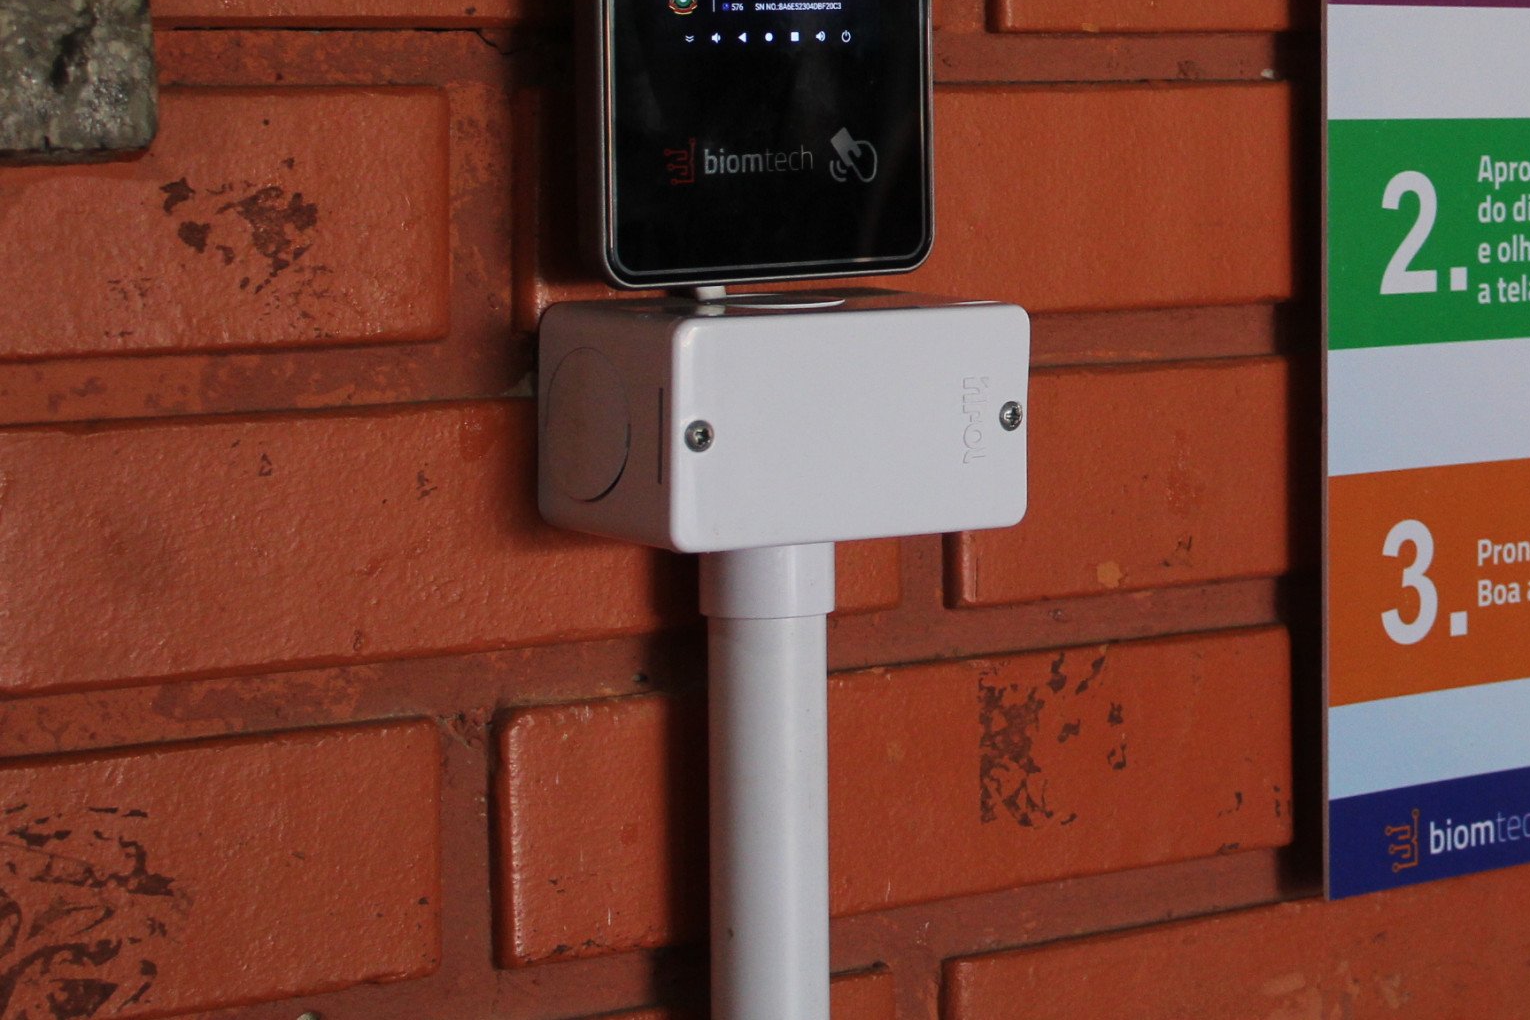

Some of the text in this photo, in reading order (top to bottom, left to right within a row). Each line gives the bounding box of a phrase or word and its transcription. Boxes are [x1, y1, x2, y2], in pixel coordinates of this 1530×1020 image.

[731, 3, 744, 11] 576
[704, 144, 814, 175] biomtech
[1478, 194, 1506, 223] do
[1379, 170, 1468, 295] 2.
[1478, 241, 1491, 263] e
[1478, 282, 1491, 304] a
[1381, 519, 1468, 645] 3.
[1477, 579, 1521, 607] Boa
